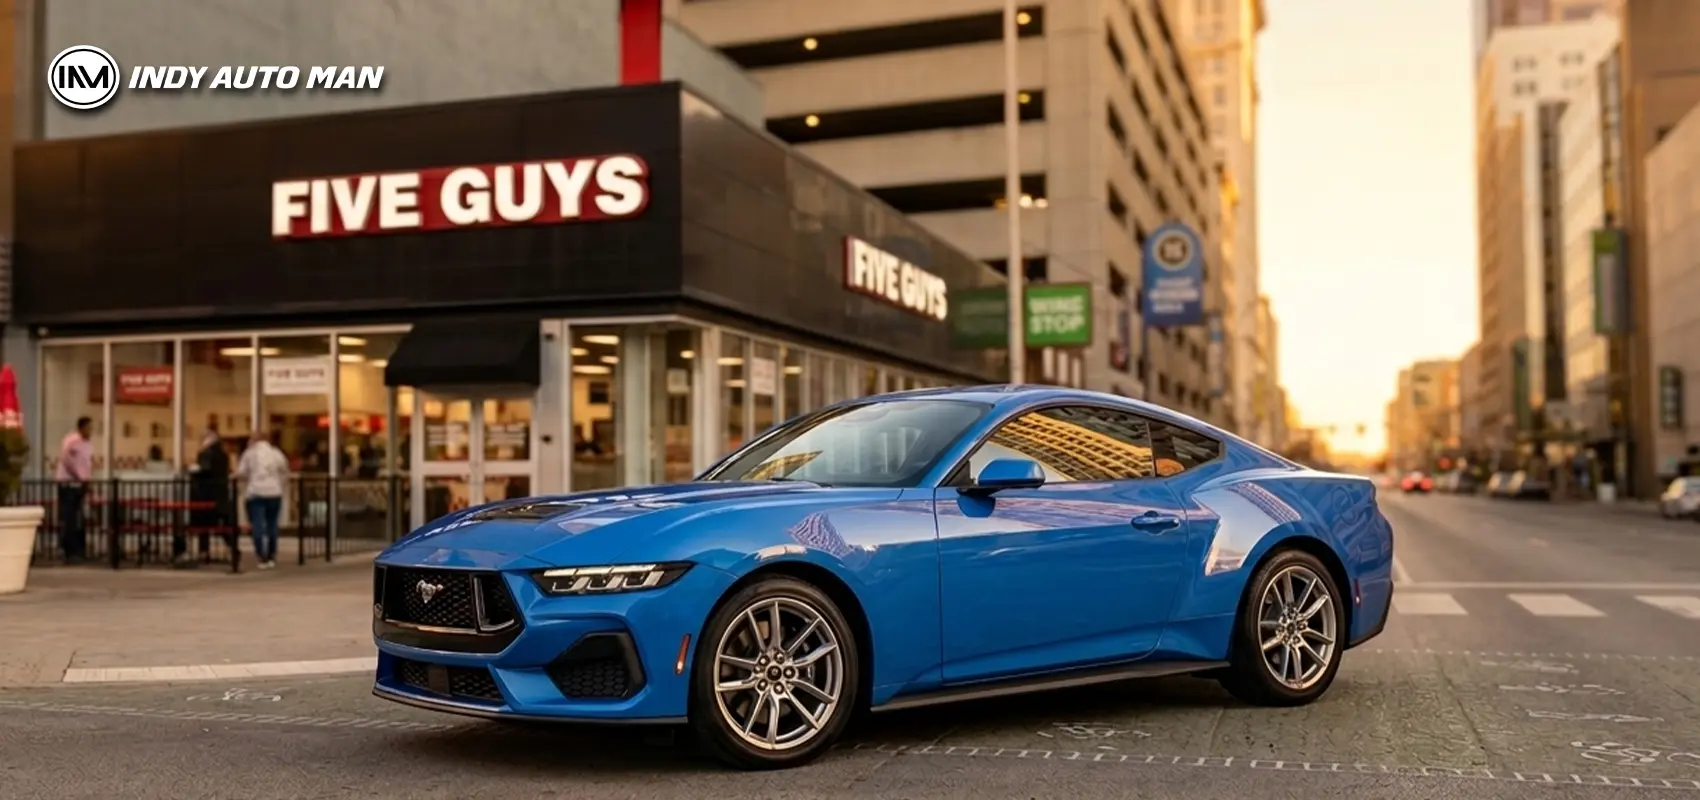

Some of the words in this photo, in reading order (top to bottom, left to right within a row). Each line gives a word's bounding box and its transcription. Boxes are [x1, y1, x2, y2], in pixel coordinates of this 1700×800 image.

[272, 172, 421, 236] FIVE
[440, 156, 644, 225] GUYS
[853, 238, 900, 302] FIVE
[901, 261, 948, 320] GUYS
[1029, 314, 1085, 334] STOP
